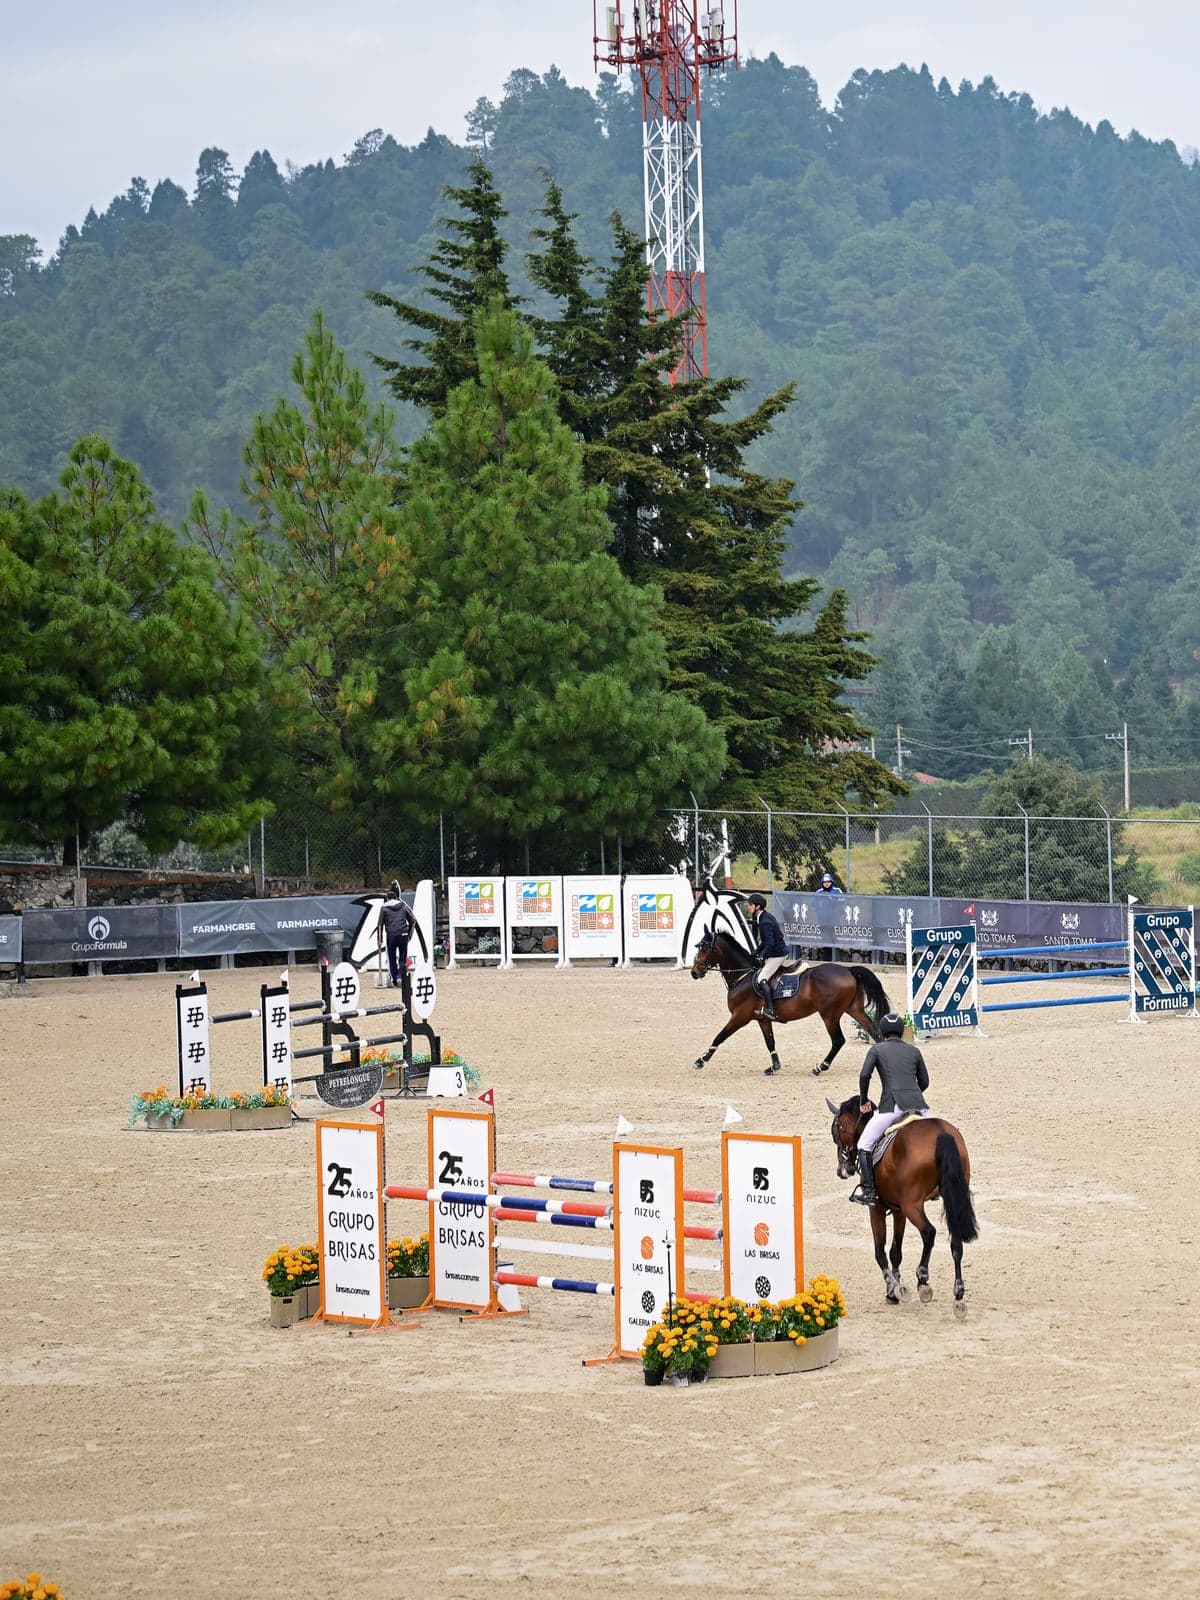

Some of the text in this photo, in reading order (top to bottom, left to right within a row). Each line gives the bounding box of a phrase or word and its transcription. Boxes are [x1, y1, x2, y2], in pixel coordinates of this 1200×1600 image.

[193, 922, 256, 934] FARMAHORSE
[277, 918, 338, 929] FARMAHORSE
[1147, 915, 1179, 928] Grupo
[784, 923, 822, 935] EUROPEOS
[834, 925, 873, 937] EUROPEOS
[927, 929, 962, 945] Grupo
[1044, 936, 1070, 945] SANTO
[72, 940, 128, 952] GrupoFórmula
[1143, 996, 1188, 1011] Fórmula
[922, 1012, 971, 1029] Fórmula
[455, 1072, 463, 1088] 3
[438, 1151, 485, 1188] 25 AÑOS
[327, 1162, 374, 1200] 25 AÑOS
[439, 1201, 484, 1221] GRUPO
[328, 1210, 375, 1232] GRUPO
[439, 1227, 485, 1249] BRISAS
[328, 1240, 375, 1262] BRISAS
[744, 1249, 780, 1260] LAS BRISAS
[632, 1263, 664, 1275] LAS BRISAS
[628, 1317, 650, 1327] GALERIA
